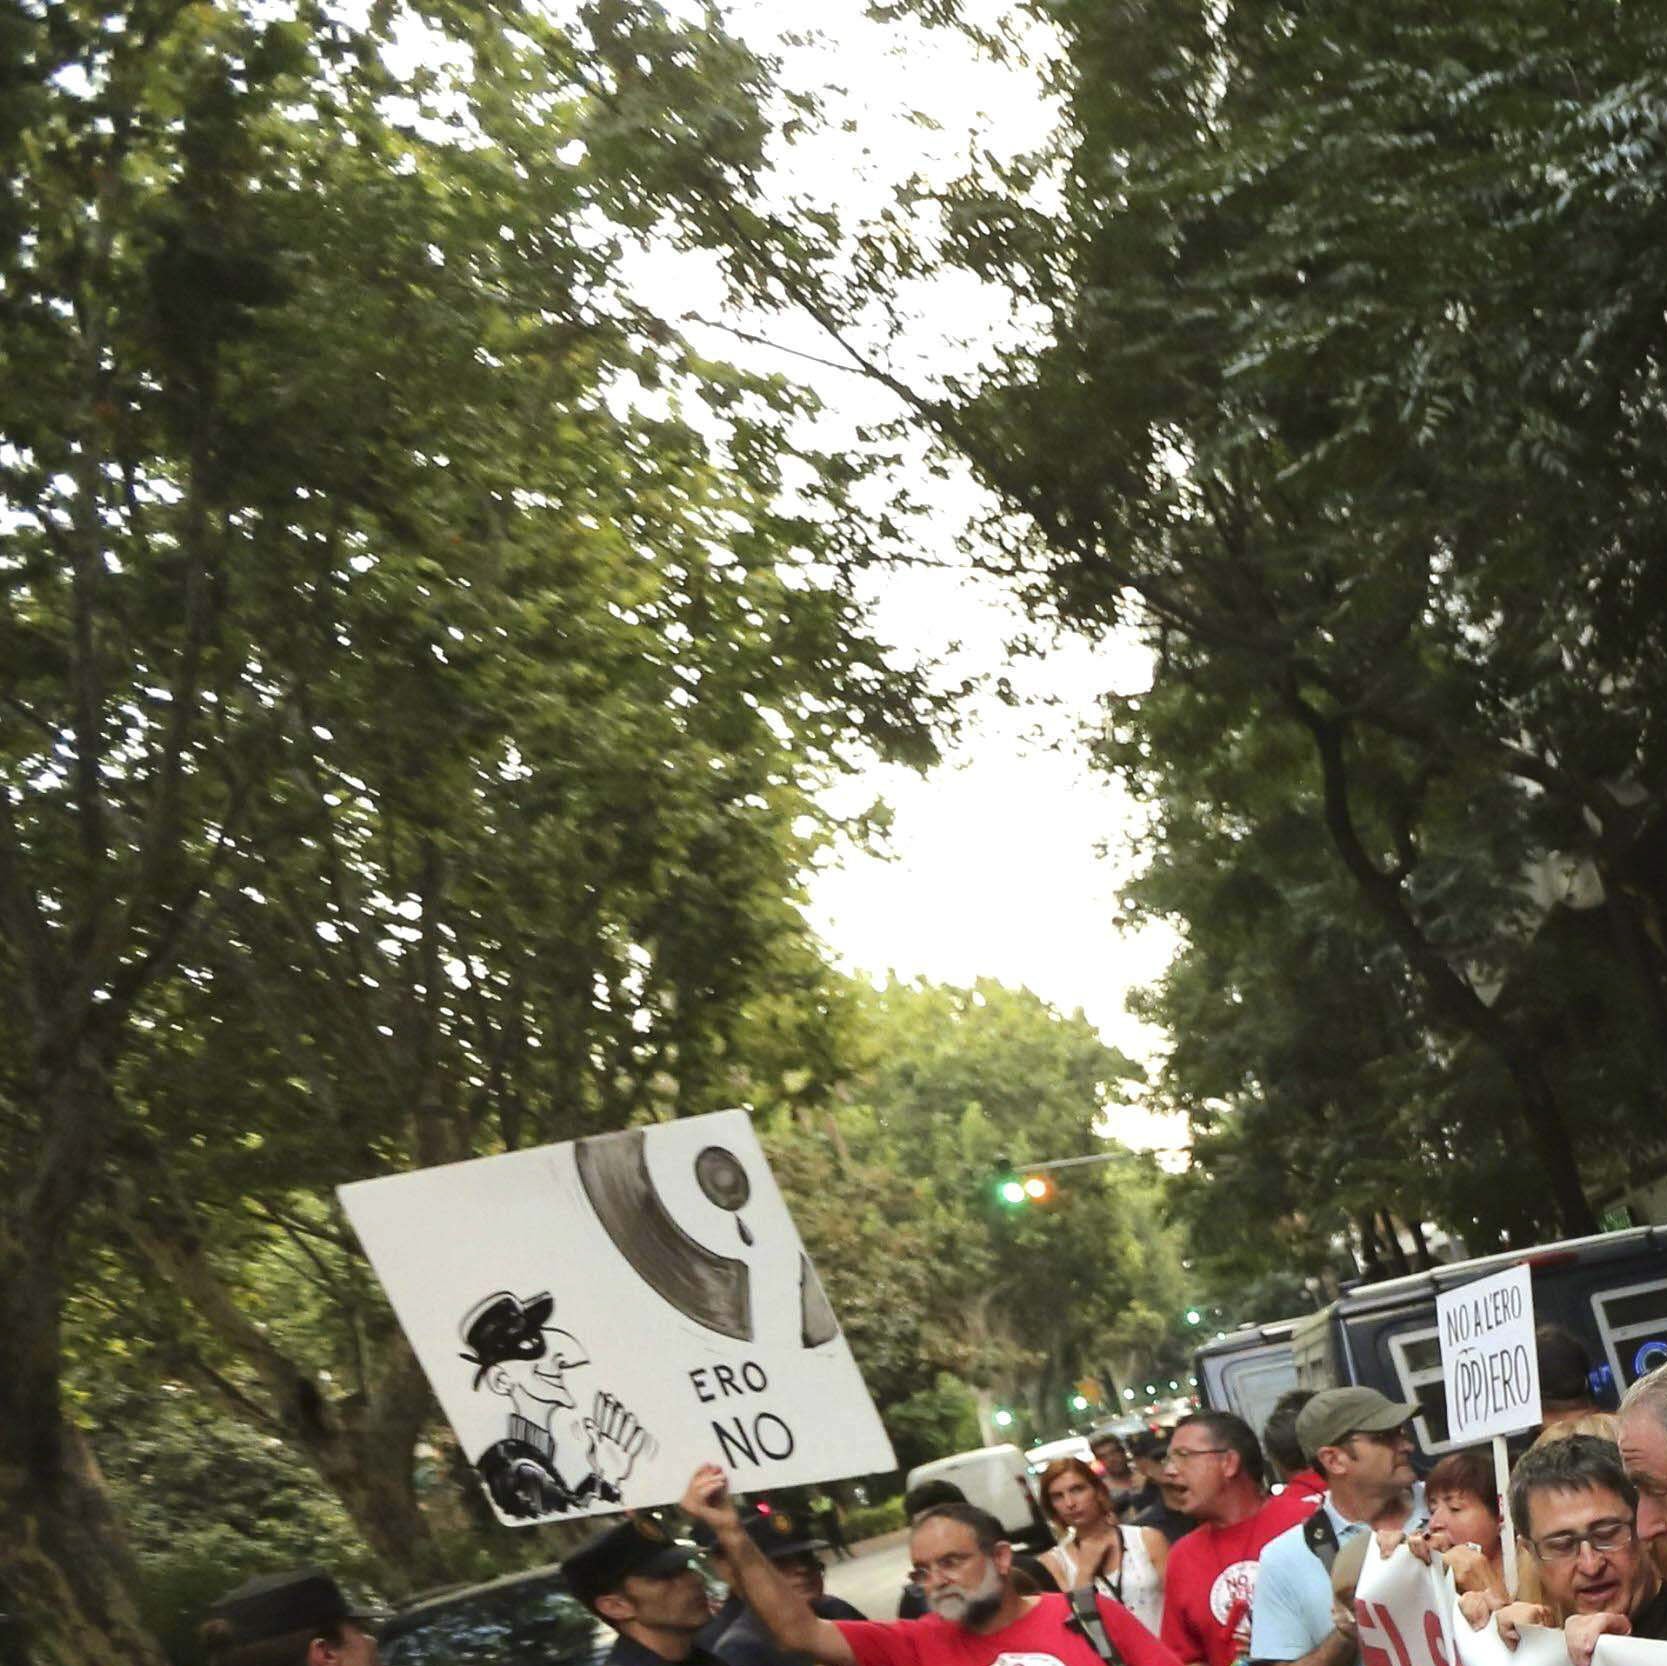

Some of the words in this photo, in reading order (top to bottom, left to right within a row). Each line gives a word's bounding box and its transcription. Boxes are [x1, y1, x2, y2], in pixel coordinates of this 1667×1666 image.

[1446, 1304, 1470, 1347] NO
[1474, 1299, 1484, 1338] A
[1484, 1285, 1522, 1330] L'ERO
[690, 1361, 767, 1402] ERO
[1454, 1344, 1531, 1431] (PP)ERO
[711, 1412, 794, 1470] NO
